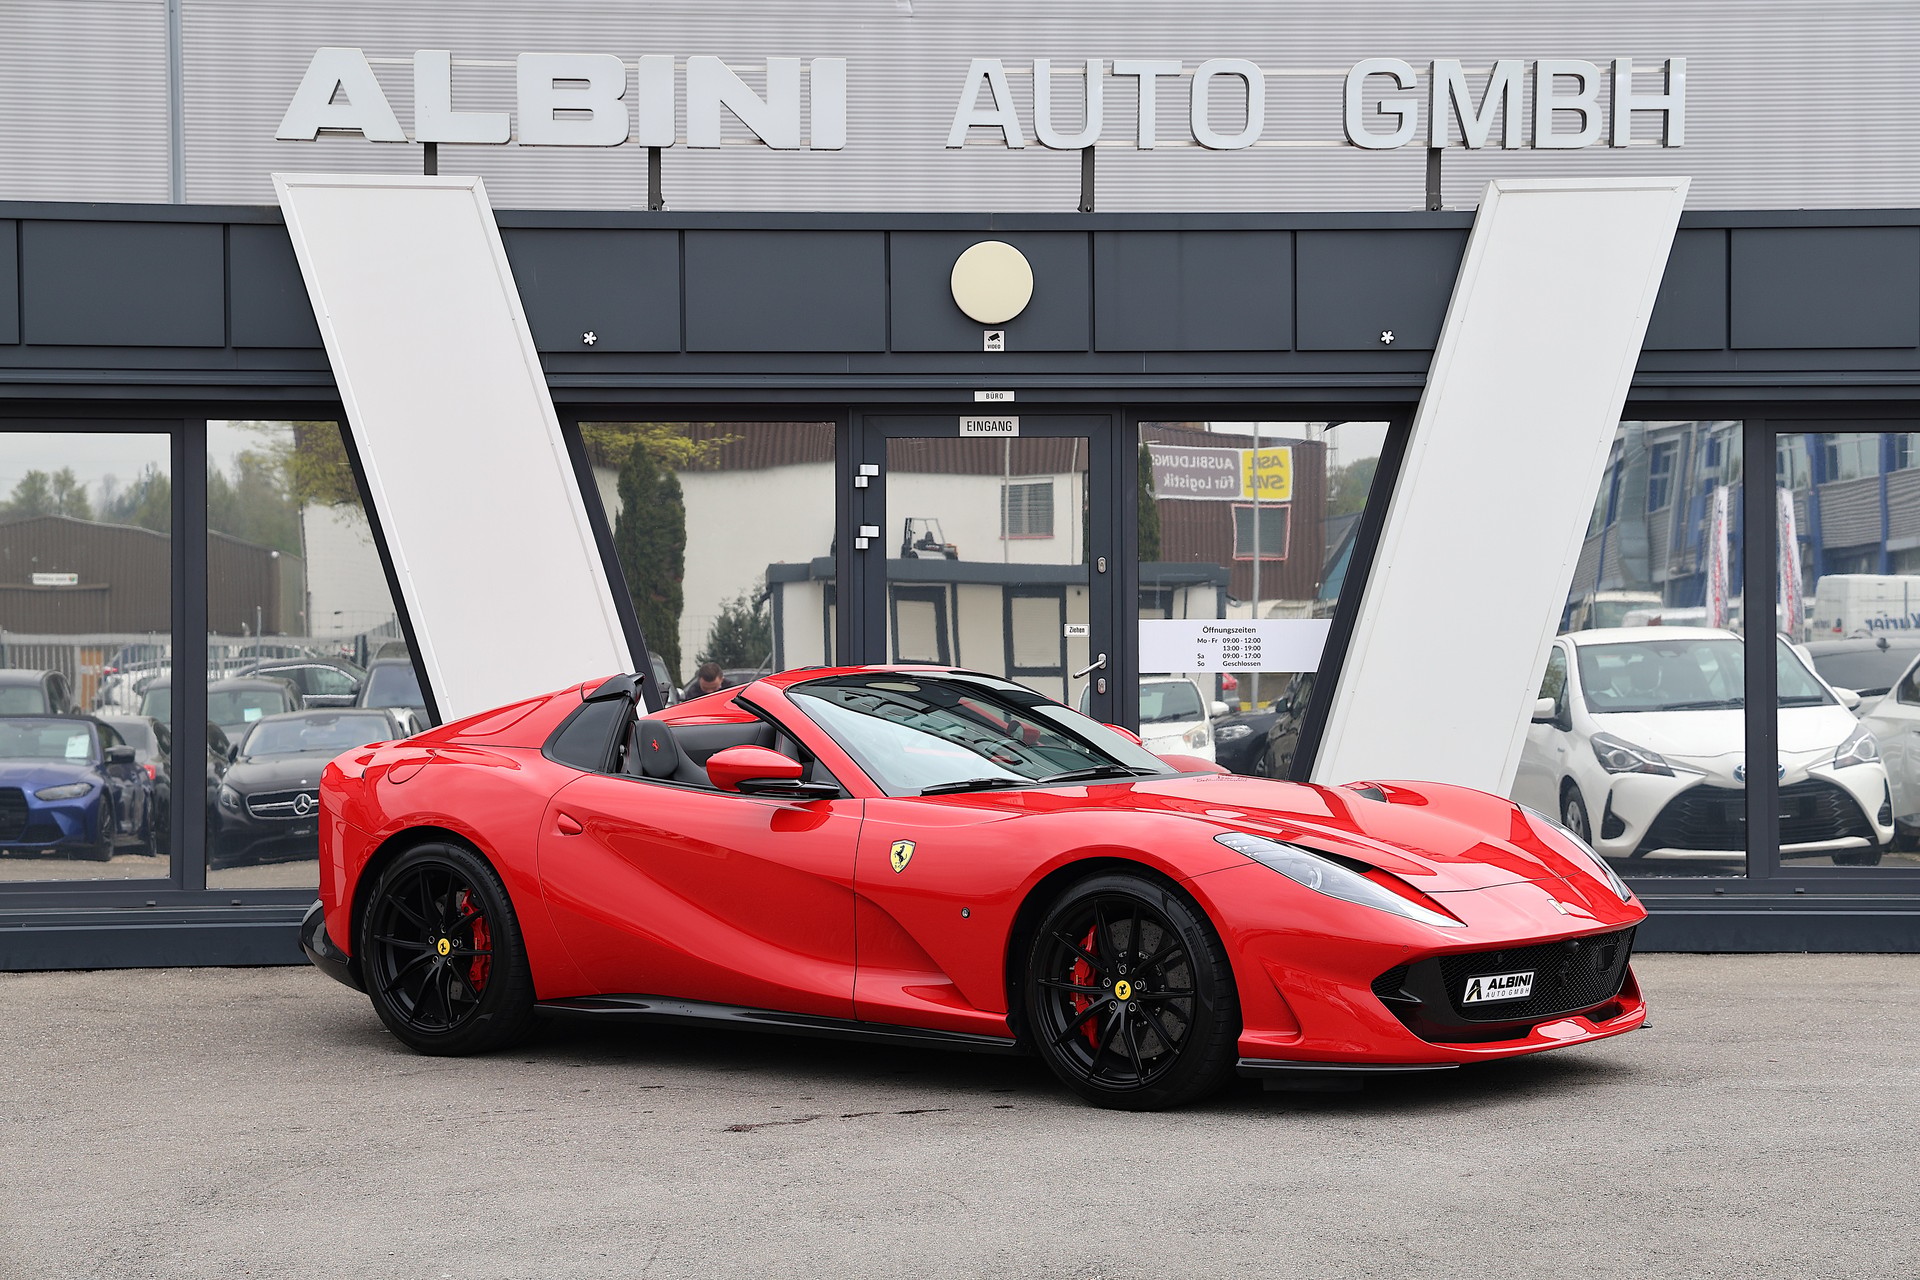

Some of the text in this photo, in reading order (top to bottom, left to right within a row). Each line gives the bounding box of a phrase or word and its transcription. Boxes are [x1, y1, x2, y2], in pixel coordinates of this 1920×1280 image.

[275, 46, 1687, 151] ALBINI AUTO GMBH
[985, 391, 1004, 400] BÜRO
[966, 420, 1013, 432] EINGANG
[1202, 625, 1257, 635] Öffnungszeiten
[1487, 974, 1532, 990] ALBINI
[1486, 987, 1530, 998] AUTO GMBH
